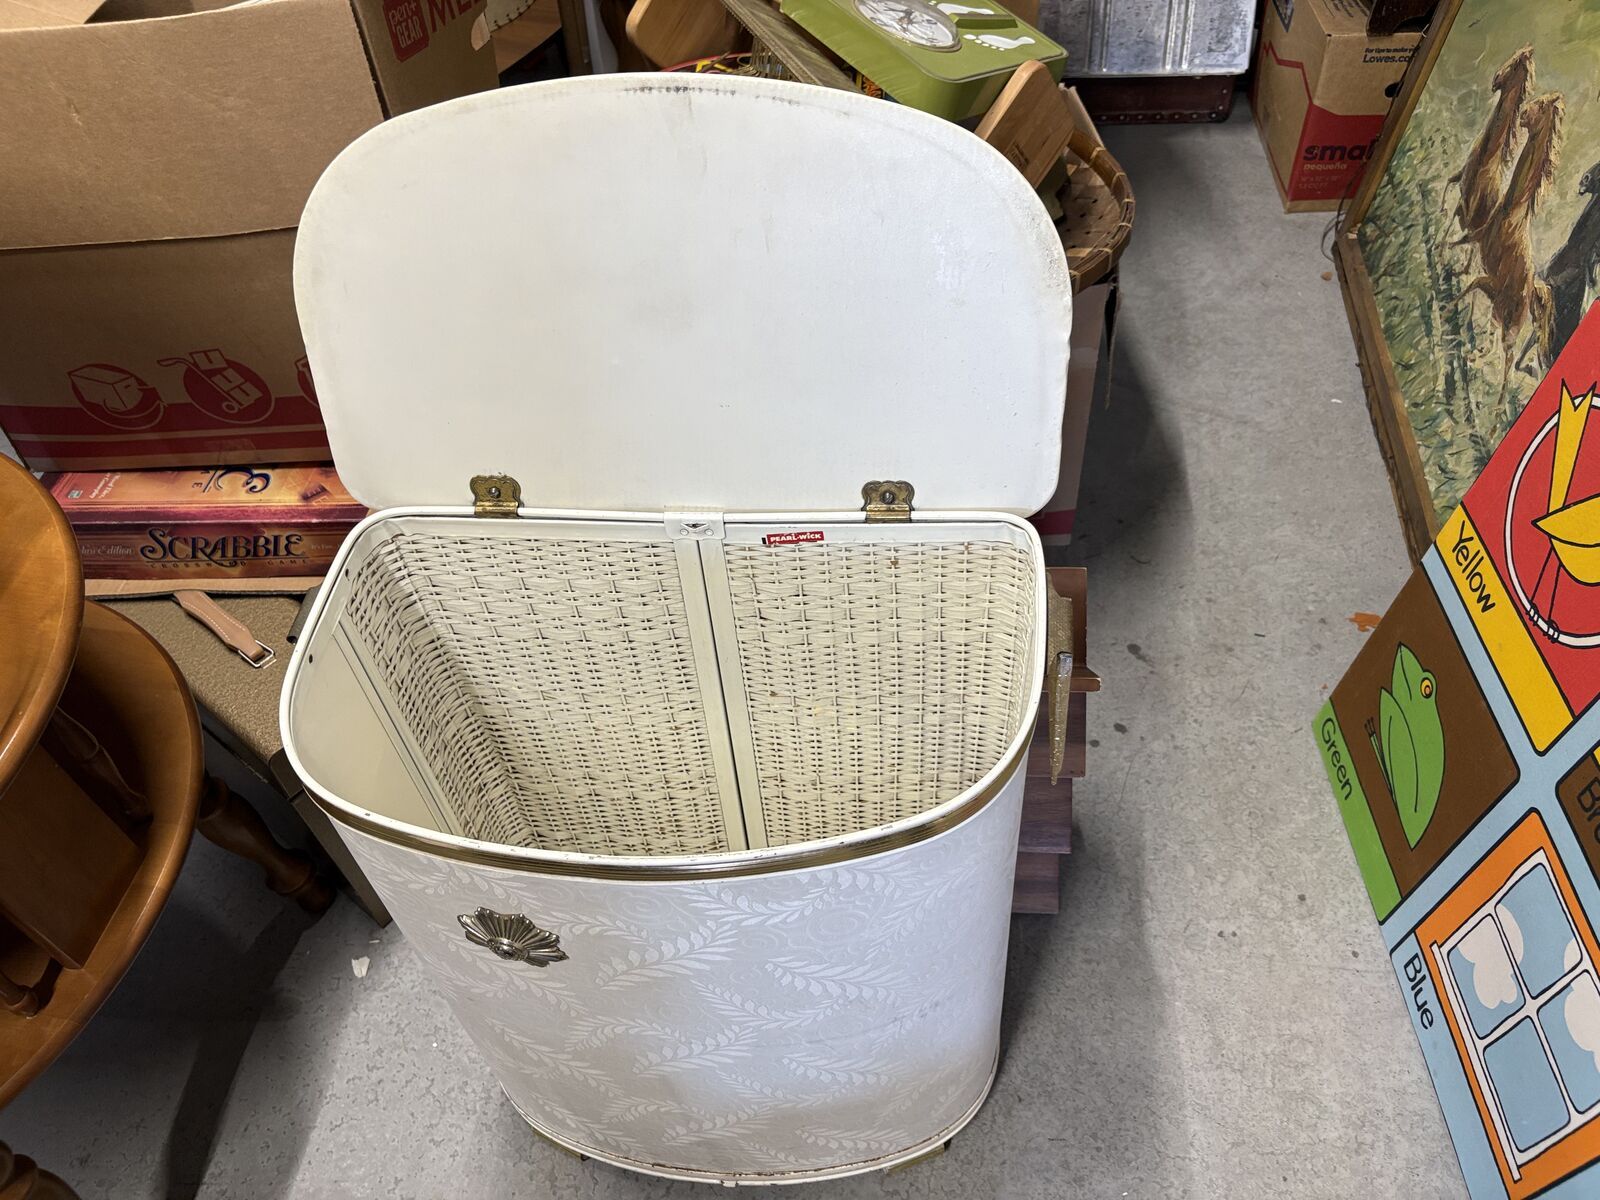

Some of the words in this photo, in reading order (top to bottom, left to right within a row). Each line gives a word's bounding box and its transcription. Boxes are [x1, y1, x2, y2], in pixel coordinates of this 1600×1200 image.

[396, 15, 423, 49] GEAR
[1362, 54, 1412, 63] Lowes.co
[1303, 138, 1377, 161] smal
[140, 527, 304, 567] SCRABBLE
[1451, 519, 1496, 613] Yellow
[1321, 717, 1353, 801] Green
[1403, 952, 1434, 1030] Blue
